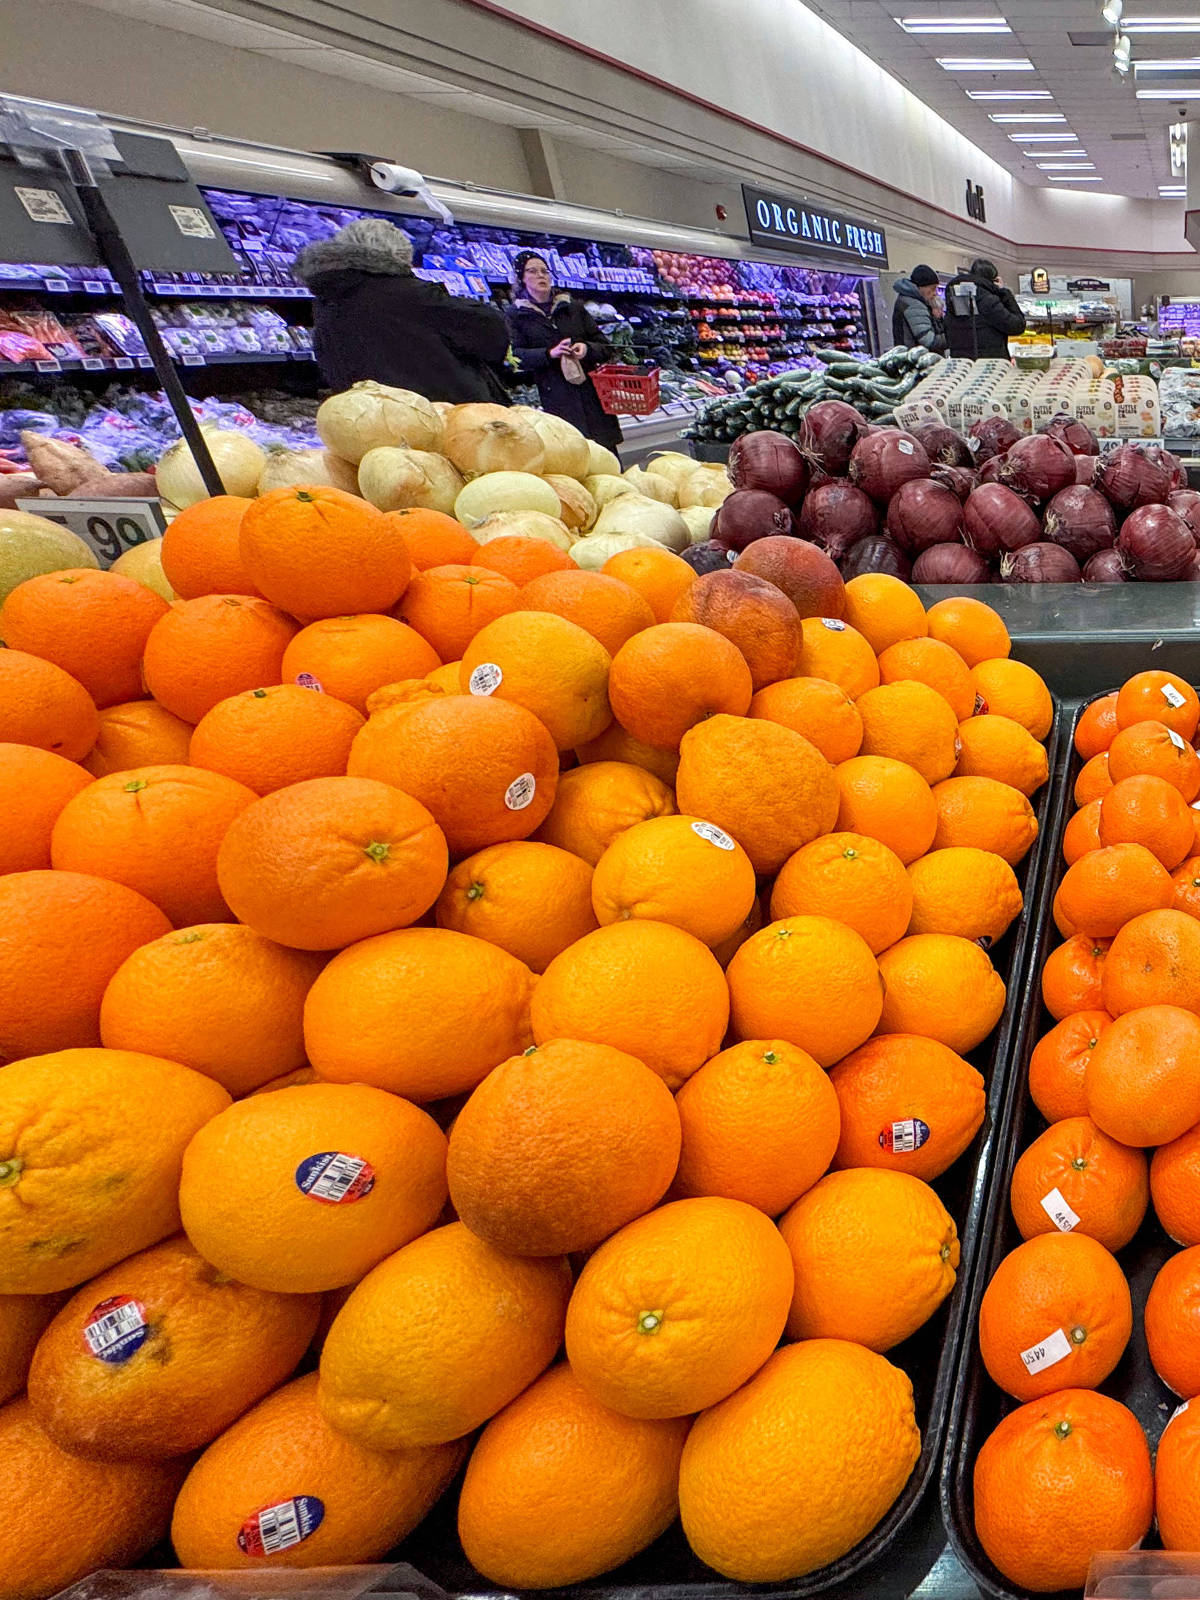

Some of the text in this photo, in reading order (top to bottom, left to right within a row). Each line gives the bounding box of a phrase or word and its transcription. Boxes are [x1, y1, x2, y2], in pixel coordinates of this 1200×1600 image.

[756, 199, 883, 258] ORGANIC FRESH
[301, 1153, 337, 1190] Sunkist
[1055, 1211, 1072, 1232] 4450
[97, 1328, 145, 1358] Sunkist
[1024, 1347, 1046, 1365] 4450
[297, 1498, 313, 1540] Sunkist
